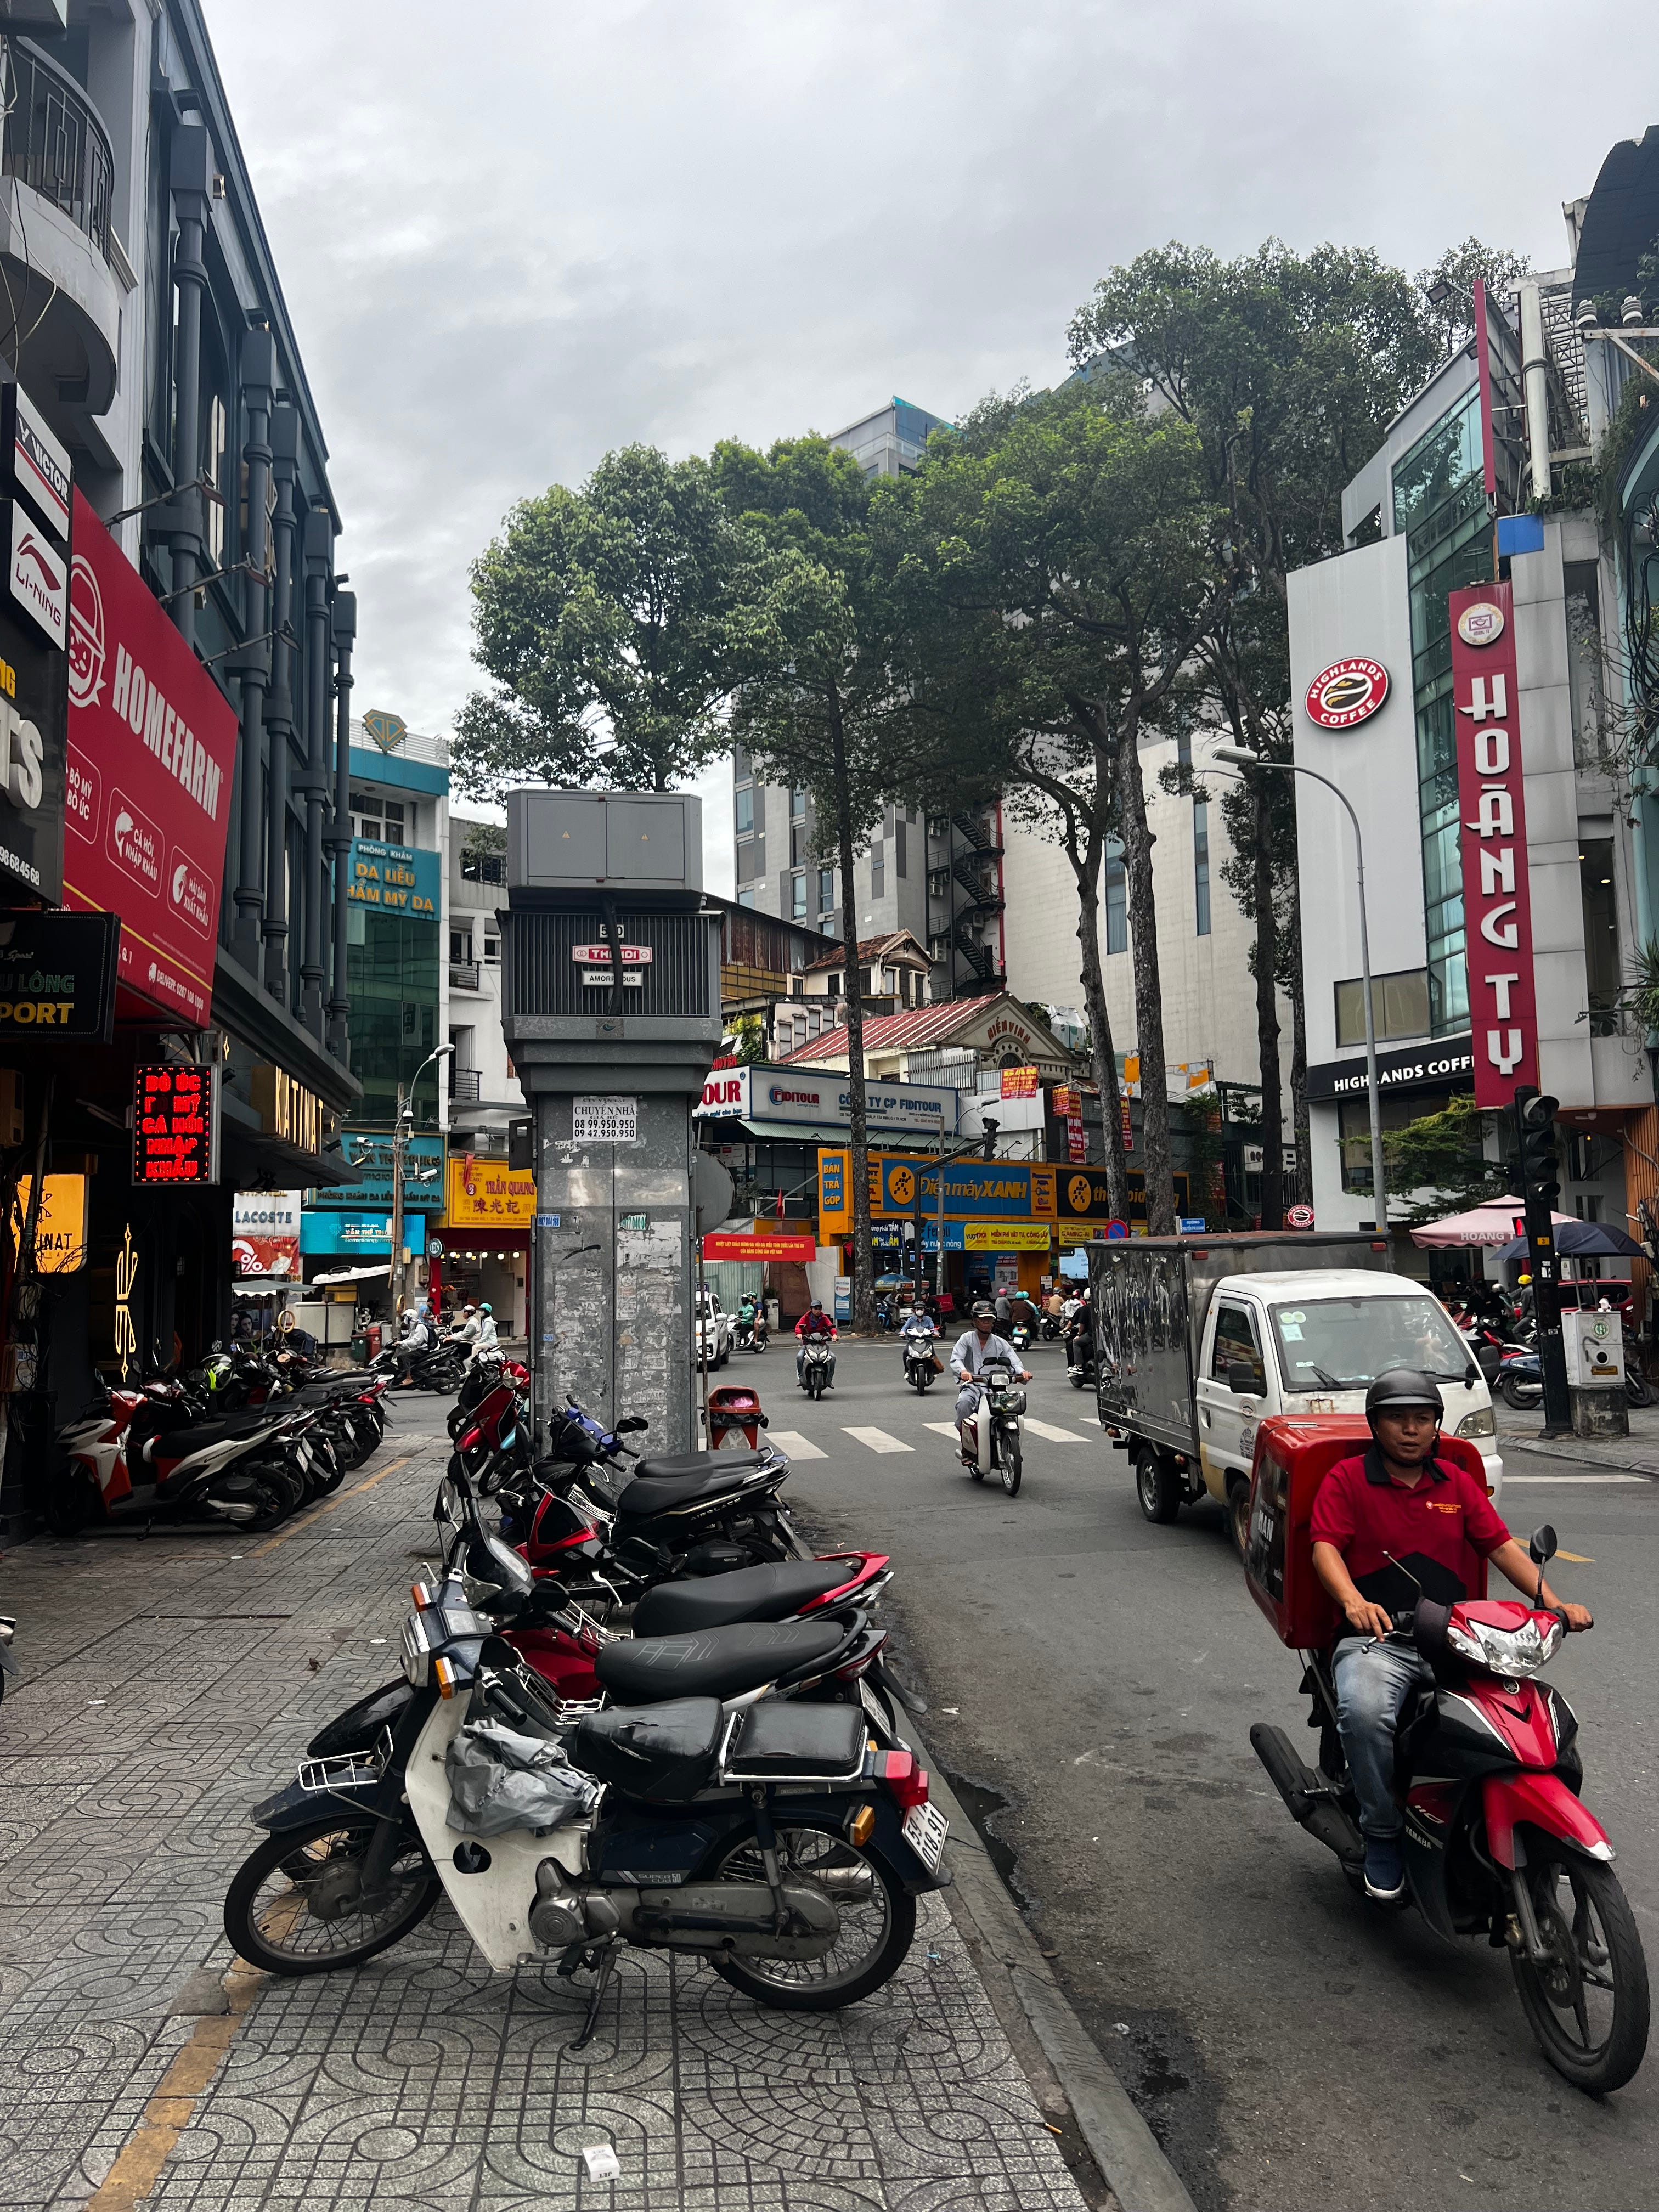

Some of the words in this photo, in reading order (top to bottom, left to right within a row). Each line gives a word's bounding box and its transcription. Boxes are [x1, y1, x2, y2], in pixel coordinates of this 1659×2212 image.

[32, 435, 69, 502] VICTOR
[16, 562, 61, 627] LI-NING
[1310, 661, 1383, 699] HIGHLANDS
[1320, 698, 1376, 724] COFFEE
[112, 642, 221, 821] HOMEFARM
[358, 843, 387, 856] PHÒNG
[390, 849, 413, 861] KHÁM
[357, 862, 379, 879] DA
[385, 864, 415, 886] LIỄU
[347, 878, 380, 902] HẨM
[385, 889, 408, 905] MỸ
[412, 895, 434, 911] DA
[601, 926, 623, 936] 50
[18, 970, 75, 994] LÔNG
[1334, 1064, 1423, 1092] HIGHANDS
[1427, 1055, 1475, 1075] COFF
[774, 1090, 820, 1104] FIDITOUR
[868, 1096, 881, 1108] TY
[883, 1097, 897, 1109] CP
[900, 1098, 942, 1113] FIDITOUR
[574, 1101, 614, 1115] CHUYỂN
[616, 1104, 635, 1115] NHÀ
[574, 1119, 585, 1128] 08
[588, 1119, 635, 1129] 99.950.950
[574, 1129, 585, 1137] 09
[588, 1129, 635, 1137] 42.950.950
[823, 1162, 840, 1174] BÁN
[486, 1174, 507, 1195] TRẦN
[508, 1181, 535, 1197] QUANG
[824, 1176, 840, 1189] TRẢ
[951, 1180, 983, 1201] máy
[982, 1180, 1028, 1199] XANH
[824, 1193, 841, 1205] GÓP
[235, 1210, 292, 1223] LACOSTE
[1289, 1205, 1313, 1216] HIGHLANDS
[430, 1243, 439, 1252] 136
[1406, 1824, 1431, 1849] YAMAHA
[672, 1873, 681, 1883] 50
